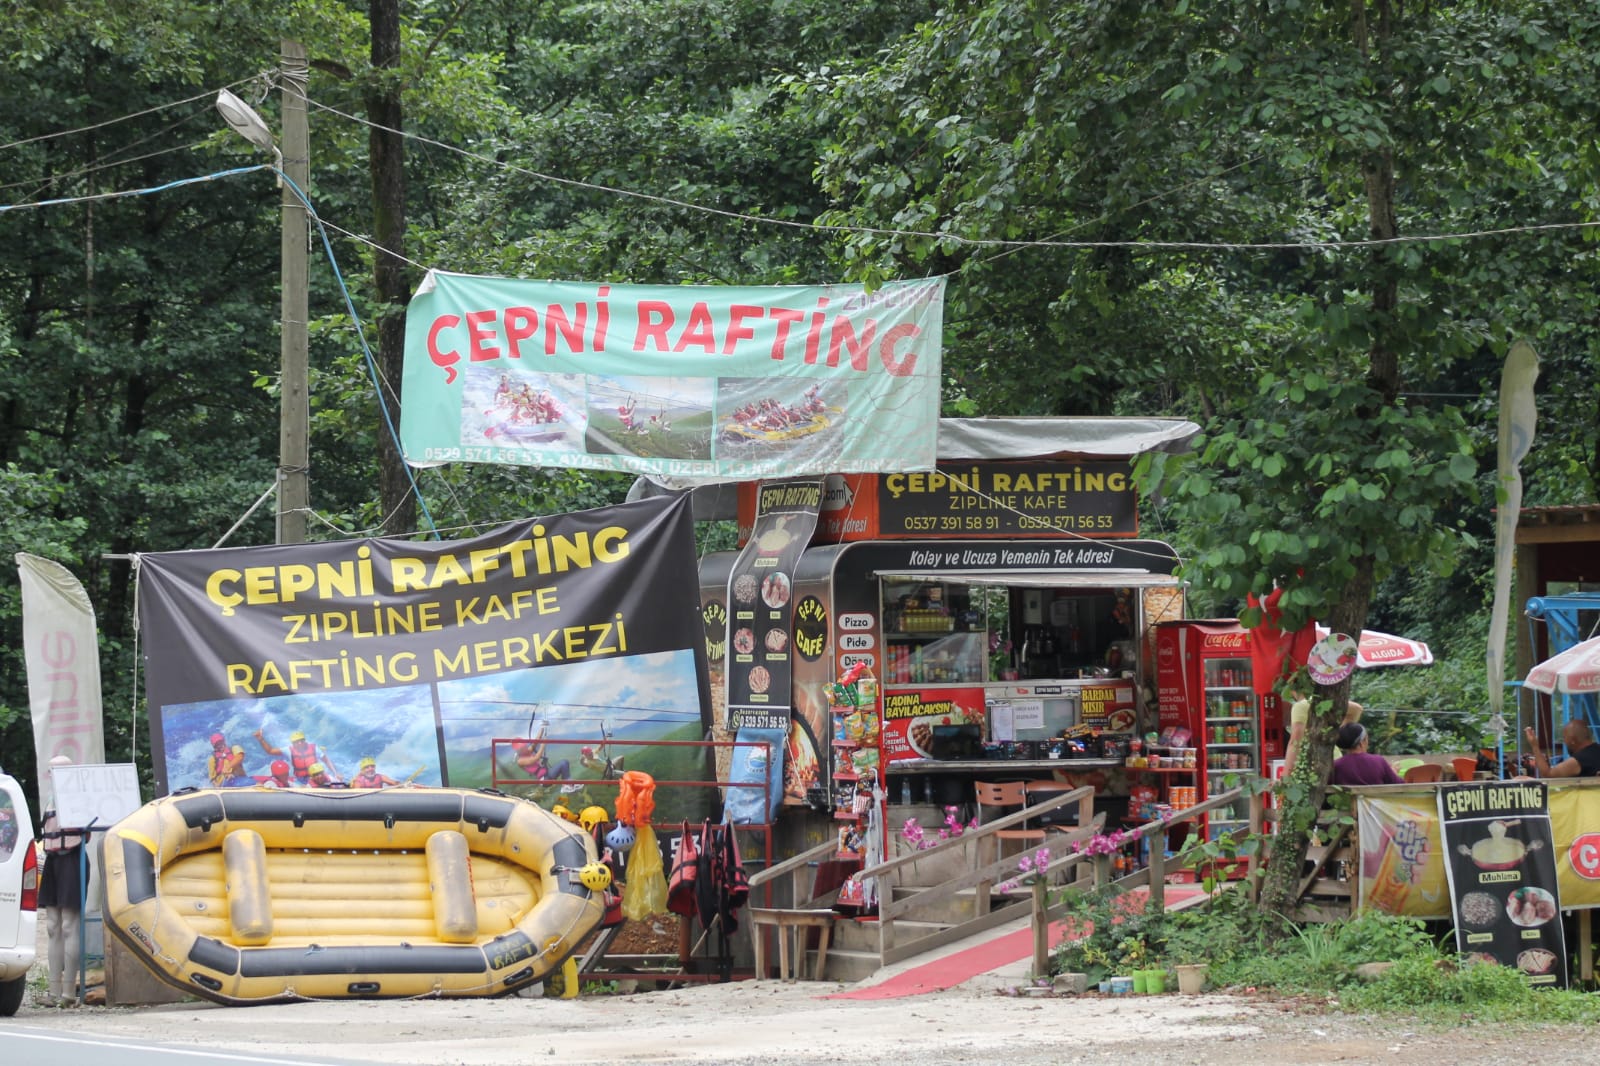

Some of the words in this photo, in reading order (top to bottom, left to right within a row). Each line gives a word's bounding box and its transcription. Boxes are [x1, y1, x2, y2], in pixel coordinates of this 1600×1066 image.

[426, 286, 611, 385] ÇEPNİ
[632, 297, 921, 377] RAFTİNG
[886, 467, 981, 498] ÇEPNİ
[993, 467, 1127, 492] RAFTİNG
[950, 492, 1017, 510] ZIPLİNE
[1024, 495, 1067, 509] KAFE
[904, 516, 936, 530] 0537
[940, 516, 962, 529] 391
[966, 516, 982, 529] 58
[986, 516, 999, 529] 91
[1018, 515, 1050, 529] 0539
[1054, 515, 1075, 528] 571
[1078, 515, 1094, 528] 56
[1097, 515, 1113, 528] 53
[909, 550, 942, 567] Kolay
[945, 554, 960, 565] ve
[962, 550, 997, 565] Ucuza
[1000, 550, 1050, 564] Yemenin
[1053, 550, 1073, 564] Tek
[1076, 549, 1114, 564] Adresi
[205, 545, 376, 616] ÇEPNİ
[391, 524, 631, 592] RAFTİNG
[281, 599, 444, 644] ZIPLİNE
[456, 586, 561, 626] KAFE
[844, 617, 868, 627] Pizza
[797, 629, 823, 656] CAFÉ
[846, 637, 867, 647] Pide
[226, 649, 419, 695] RAFTİNG
[434, 612, 628, 677] MERKEZİ
[1371, 649, 1403, 659] ALGIDA
[885, 695, 920, 707] TADINA
[1082, 689, 1115, 701] BARDAK
[885, 702, 951, 718] BAYILACAKSIN
[1082, 702, 1105, 713] MISIR
[1447, 786, 1486, 819] ÇEPNİ
[1488, 784, 1542, 809] RAFTİNG
[1580, 844, 1599, 874] Ç
